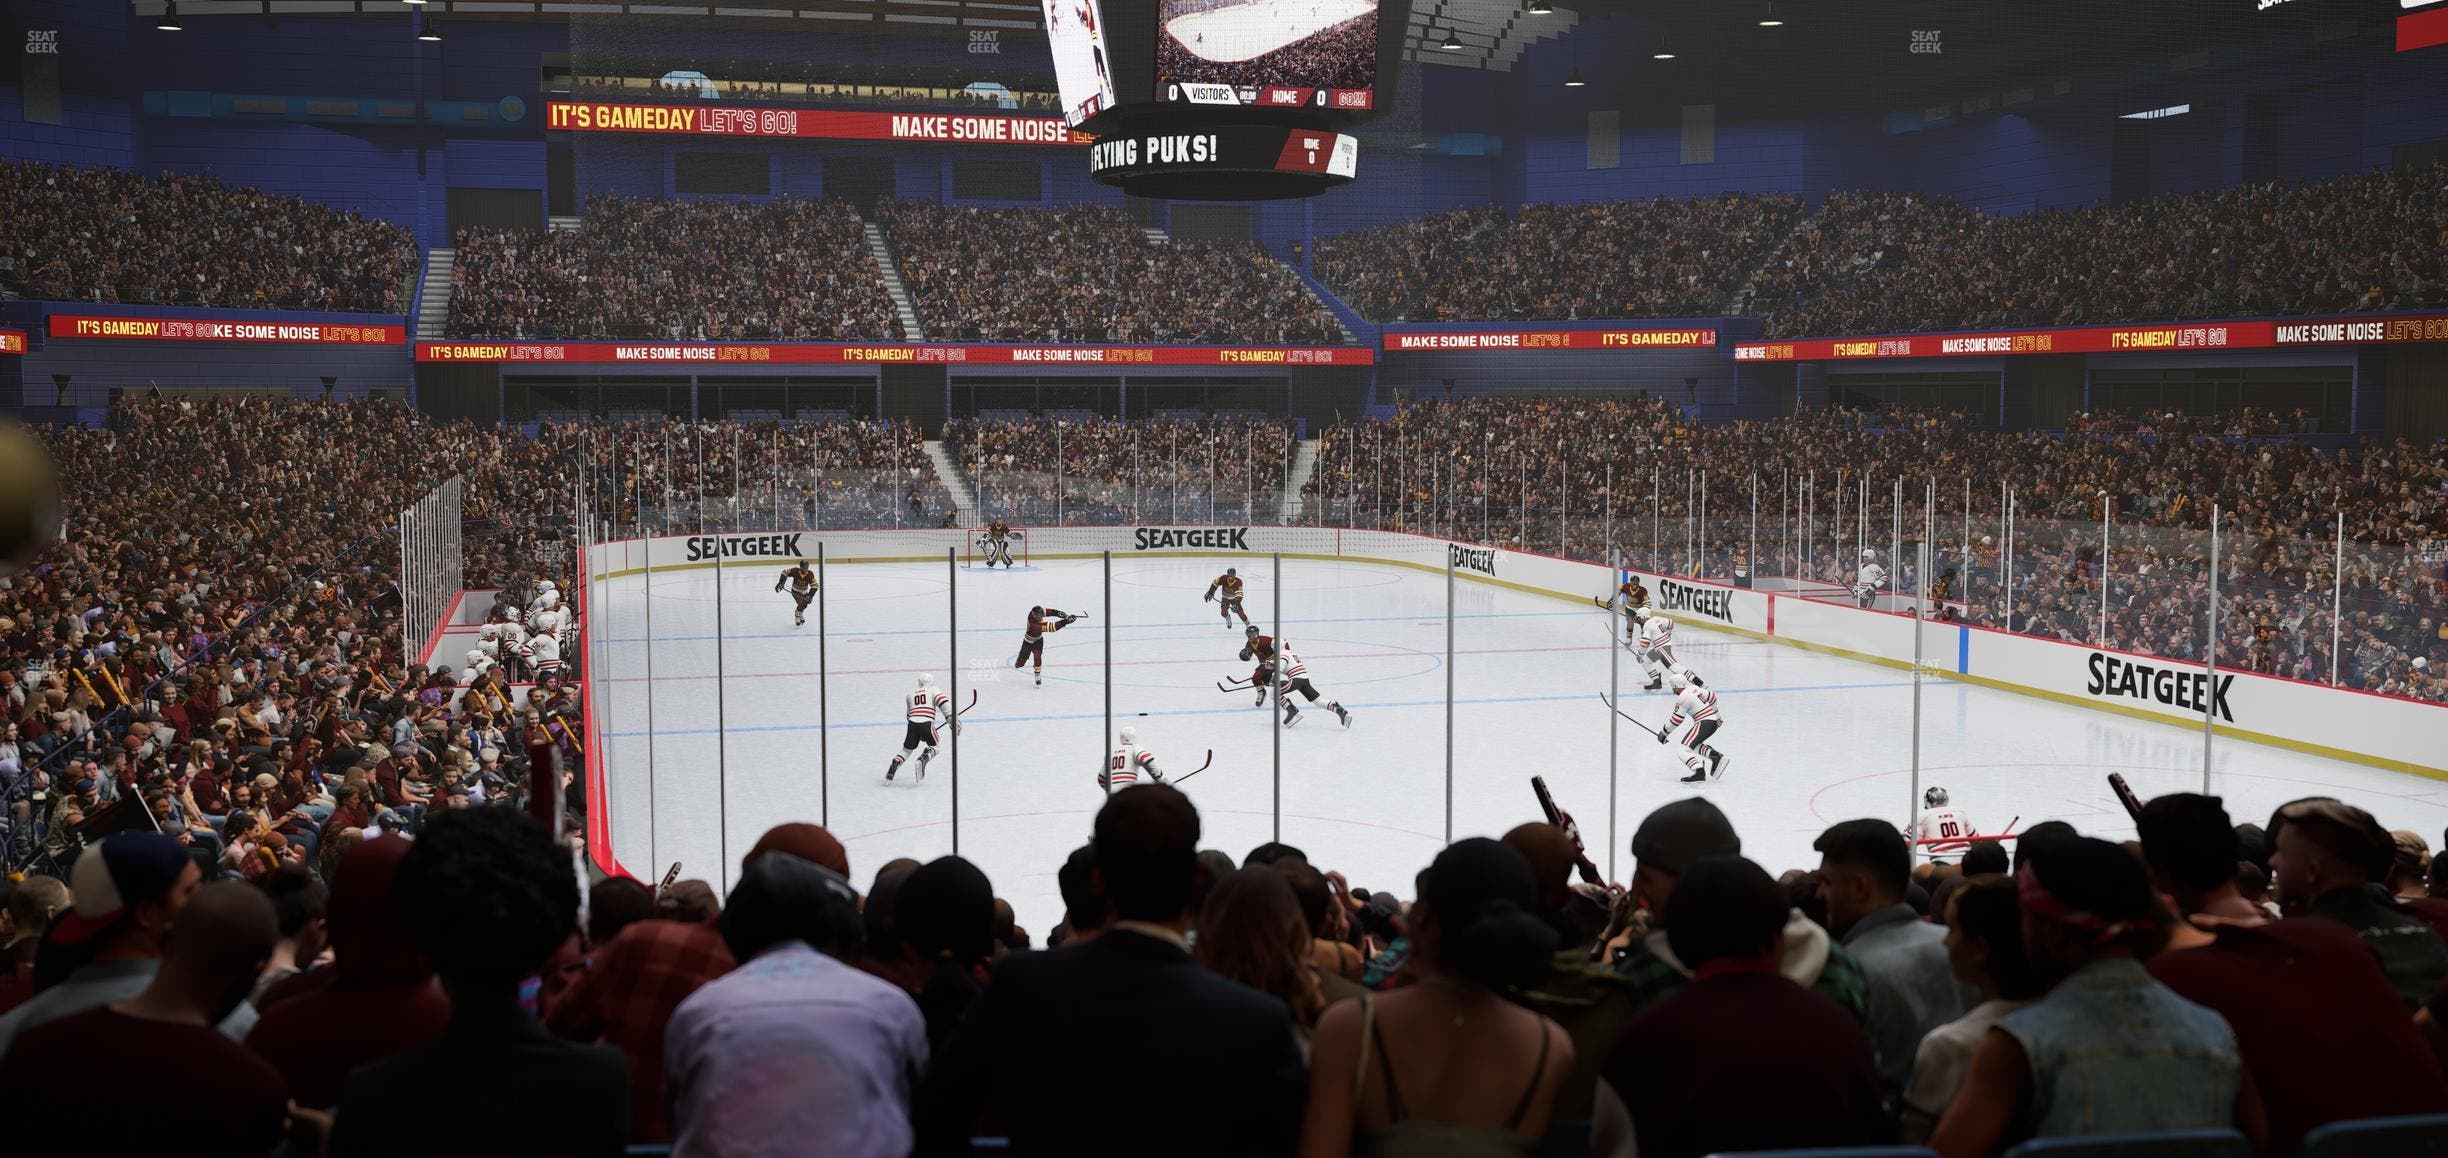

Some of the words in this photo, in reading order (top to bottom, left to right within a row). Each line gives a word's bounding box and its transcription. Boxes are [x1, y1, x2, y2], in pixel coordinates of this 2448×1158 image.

[1168, 84, 1178, 101] 0
[1192, 87, 1229, 101] VISITORS
[1272, 90, 1298, 103] HOME
[1316, 90, 1326, 106] 0
[552, 104, 590, 127] IT'S
[596, 106, 694, 130] GAMEDAY
[700, 109, 756, 133] LET'S
[761, 111, 797, 134] GO!
[892, 116, 948, 138] MAKE
[952, 118, 1006, 139] SOME
[1011, 119, 1067, 142] NOISE
[1304, 138, 1320, 150] HOME
[1094, 139, 1137, 172] FLYING
[1147, 135, 1217, 163] PUKS!
[1309, 151, 1315, 164] 0
[77, 320, 100, 334] IT'S
[103, 321, 159, 335] GAMEDAY
[162, 322, 193, 337] LET'S
[235, 325, 276, 339] SOME
[278, 326, 320, 340] NOISE
[323, 327, 359, 341] LET'S
[362, 328, 385, 342] GO!
[2277, 325, 2309, 342] MAKE
[2311, 324, 2345, 341] SOME
[2347, 322, 2383, 341] NOISE
[2386, 320, 2422, 340] LET'S
[2424, 319, 2448, 339] GO!
[1401, 336, 1438, 348] MAKE
[1440, 335, 1477, 347] SOME
[1479, 334, 1519, 347] NOISE
[1523, 334, 1560, 346] LET'S
[1602, 333, 1628, 345] IT'S
[1631, 332, 1699, 345] GAMEDAY
[1942, 338, 1964, 352] MAKE
[1964, 337, 1986, 352] SOME
[1987, 336, 2011, 351] NOISE
[2012, 335, 2035, 351] LET'S
[2036, 334, 2052, 350] GO!
[2112, 332, 2129, 347] IT'S
[2130, 330, 2176, 347] GAMEDAY
[2178, 329, 2206, 346] LET'S
[2207, 328, 2227, 345] GO!
[430, 346, 451, 358] IT'S
[454, 346, 508, 359] GAMEDAY
[510, 347, 542, 359] LET'S
[544, 347, 564, 359] GO!
[616, 347, 648, 359] MAKE
[650, 347, 681, 359] SOME
[683, 348, 716, 359] NOISE
[718, 348, 748, 360] LET'S
[750, 348, 770, 360] GO!
[843, 348, 863, 360] IT'S
[865, 348, 914, 360] GAMEDAY
[917, 348, 945, 361] LET'S
[947, 349, 966, 361] GO!
[1013, 349, 1041, 361] MAKE
[1043, 349, 1072, 361] SOME
[1073, 349, 1103, 361] NOISE
[1105, 350, 1133, 361] LET'S
[1135, 350, 1153, 361] GO!
[1220, 350, 1238, 361] IT'S
[1240, 350, 1285, 362] GAMEDAY
[1287, 350, 1313, 362] LET'S
[1315, 351, 1332, 362] GO!
[1749, 347, 1765, 359] NOISE
[1833, 343, 1846, 356] IT'S
[1846, 342, 1877, 355] GAMEDAY
[1878, 341, 1897, 355] LET'S
[687, 533, 803, 561] SEATGEEK
[1134, 526, 1249, 551] SEATGEEK
[1660, 578, 1734, 624] SEATGEEK
[2088, 652, 2235, 723] SEATGEEK
[914, 694, 926, 705] 00
[1112, 756, 1125, 770] 00
[1940, 821, 1960, 838] 00
